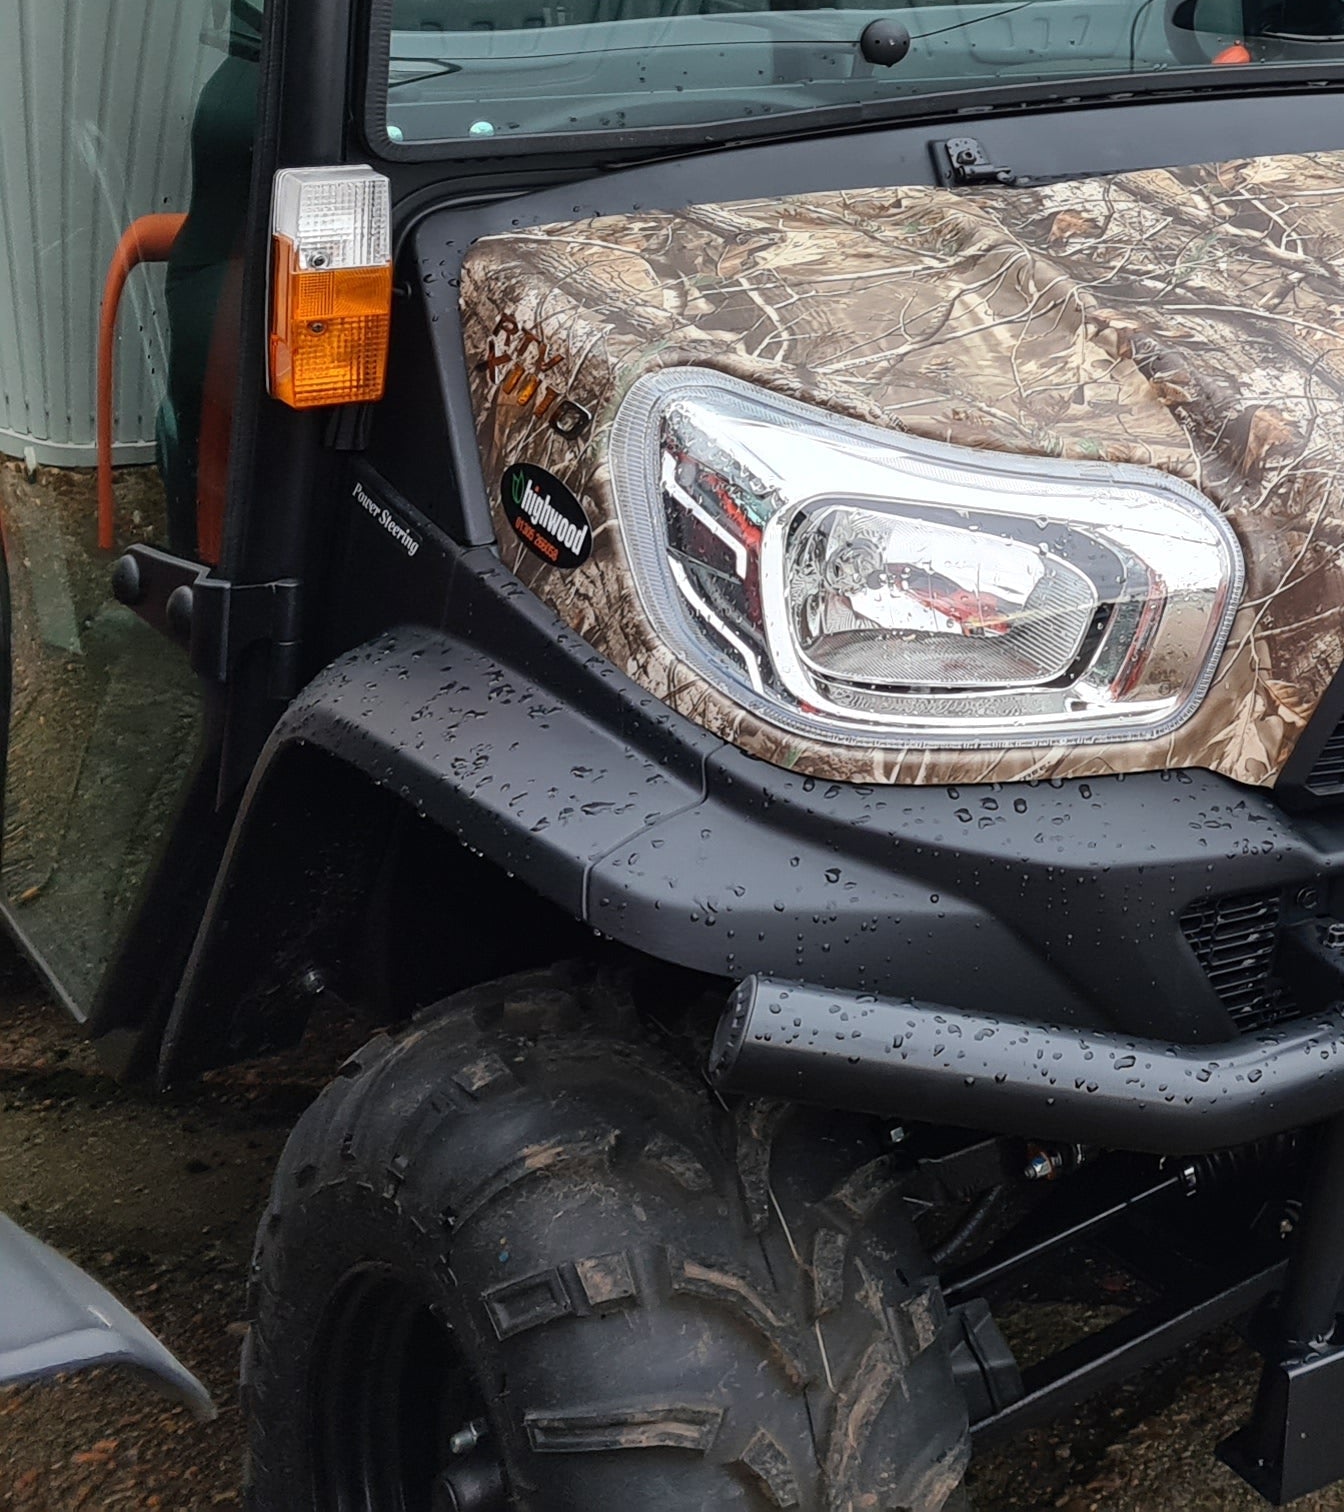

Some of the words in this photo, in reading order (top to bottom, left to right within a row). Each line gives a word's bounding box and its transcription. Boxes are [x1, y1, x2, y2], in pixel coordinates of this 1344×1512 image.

[493, 312, 565, 374] RTV
[352, 481, 381, 517] Power
[378, 509, 419, 557] Steering
[520, 479, 588, 556] highwood
